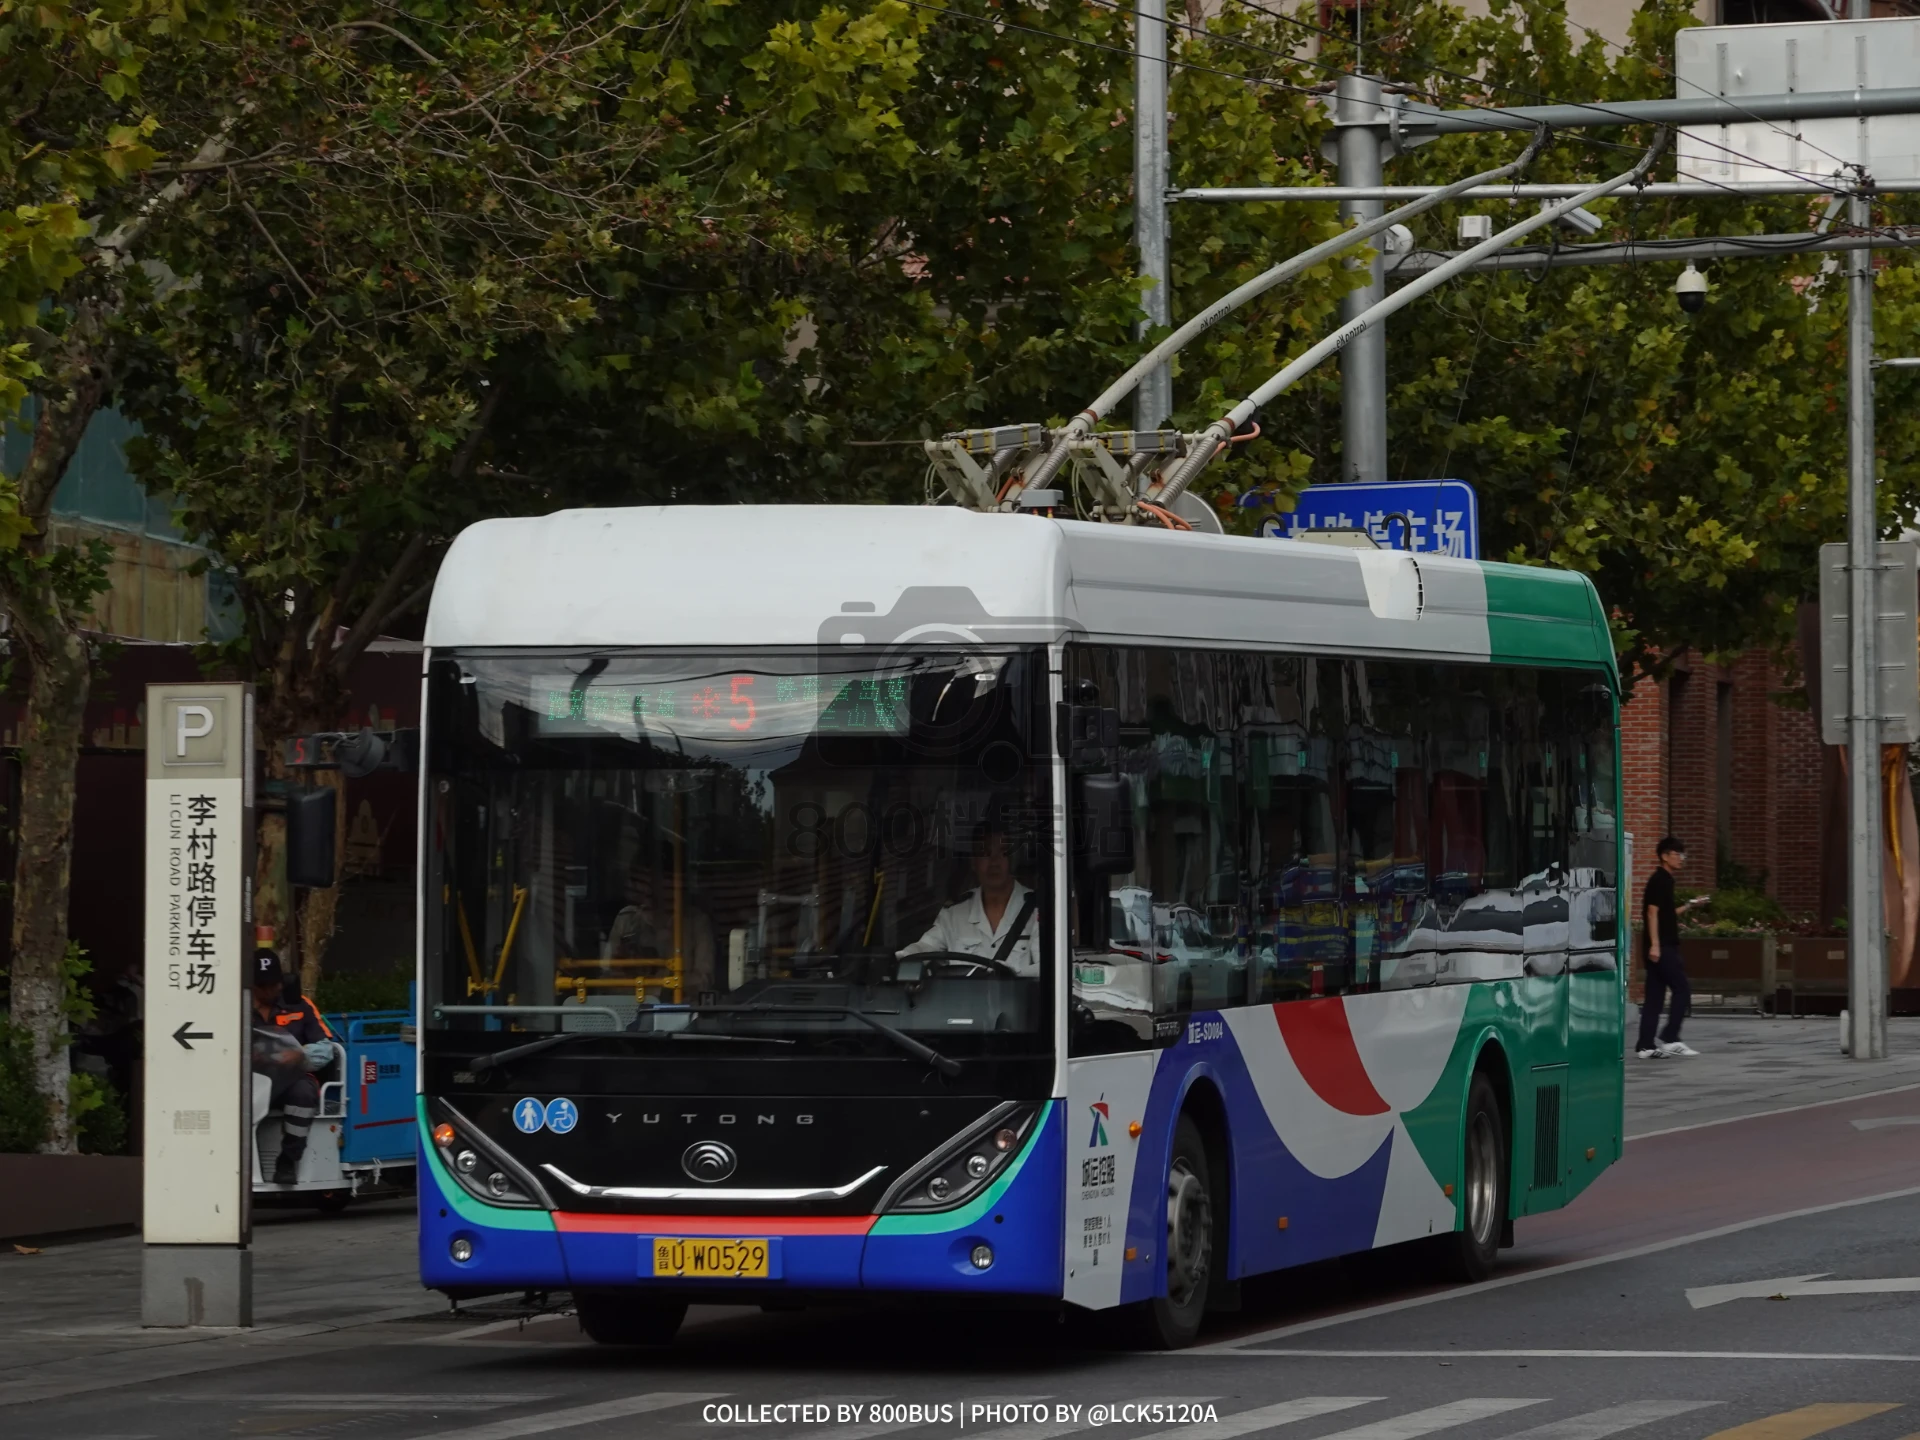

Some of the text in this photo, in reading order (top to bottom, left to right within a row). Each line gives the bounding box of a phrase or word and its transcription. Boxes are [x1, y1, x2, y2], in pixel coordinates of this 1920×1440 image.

[729, 676, 757, 731] 5
[177, 705, 214, 756] P
[295, 738, 305, 764] 5
[169, 847, 182, 887] ROAD
[186, 794, 217, 995] 李村路停车场
[168, 894, 182, 957] PARKING
[168, 963, 181, 990] LOT
[259, 958, 271, 971] P
[606, 1113, 814, 1125] YUTONG
